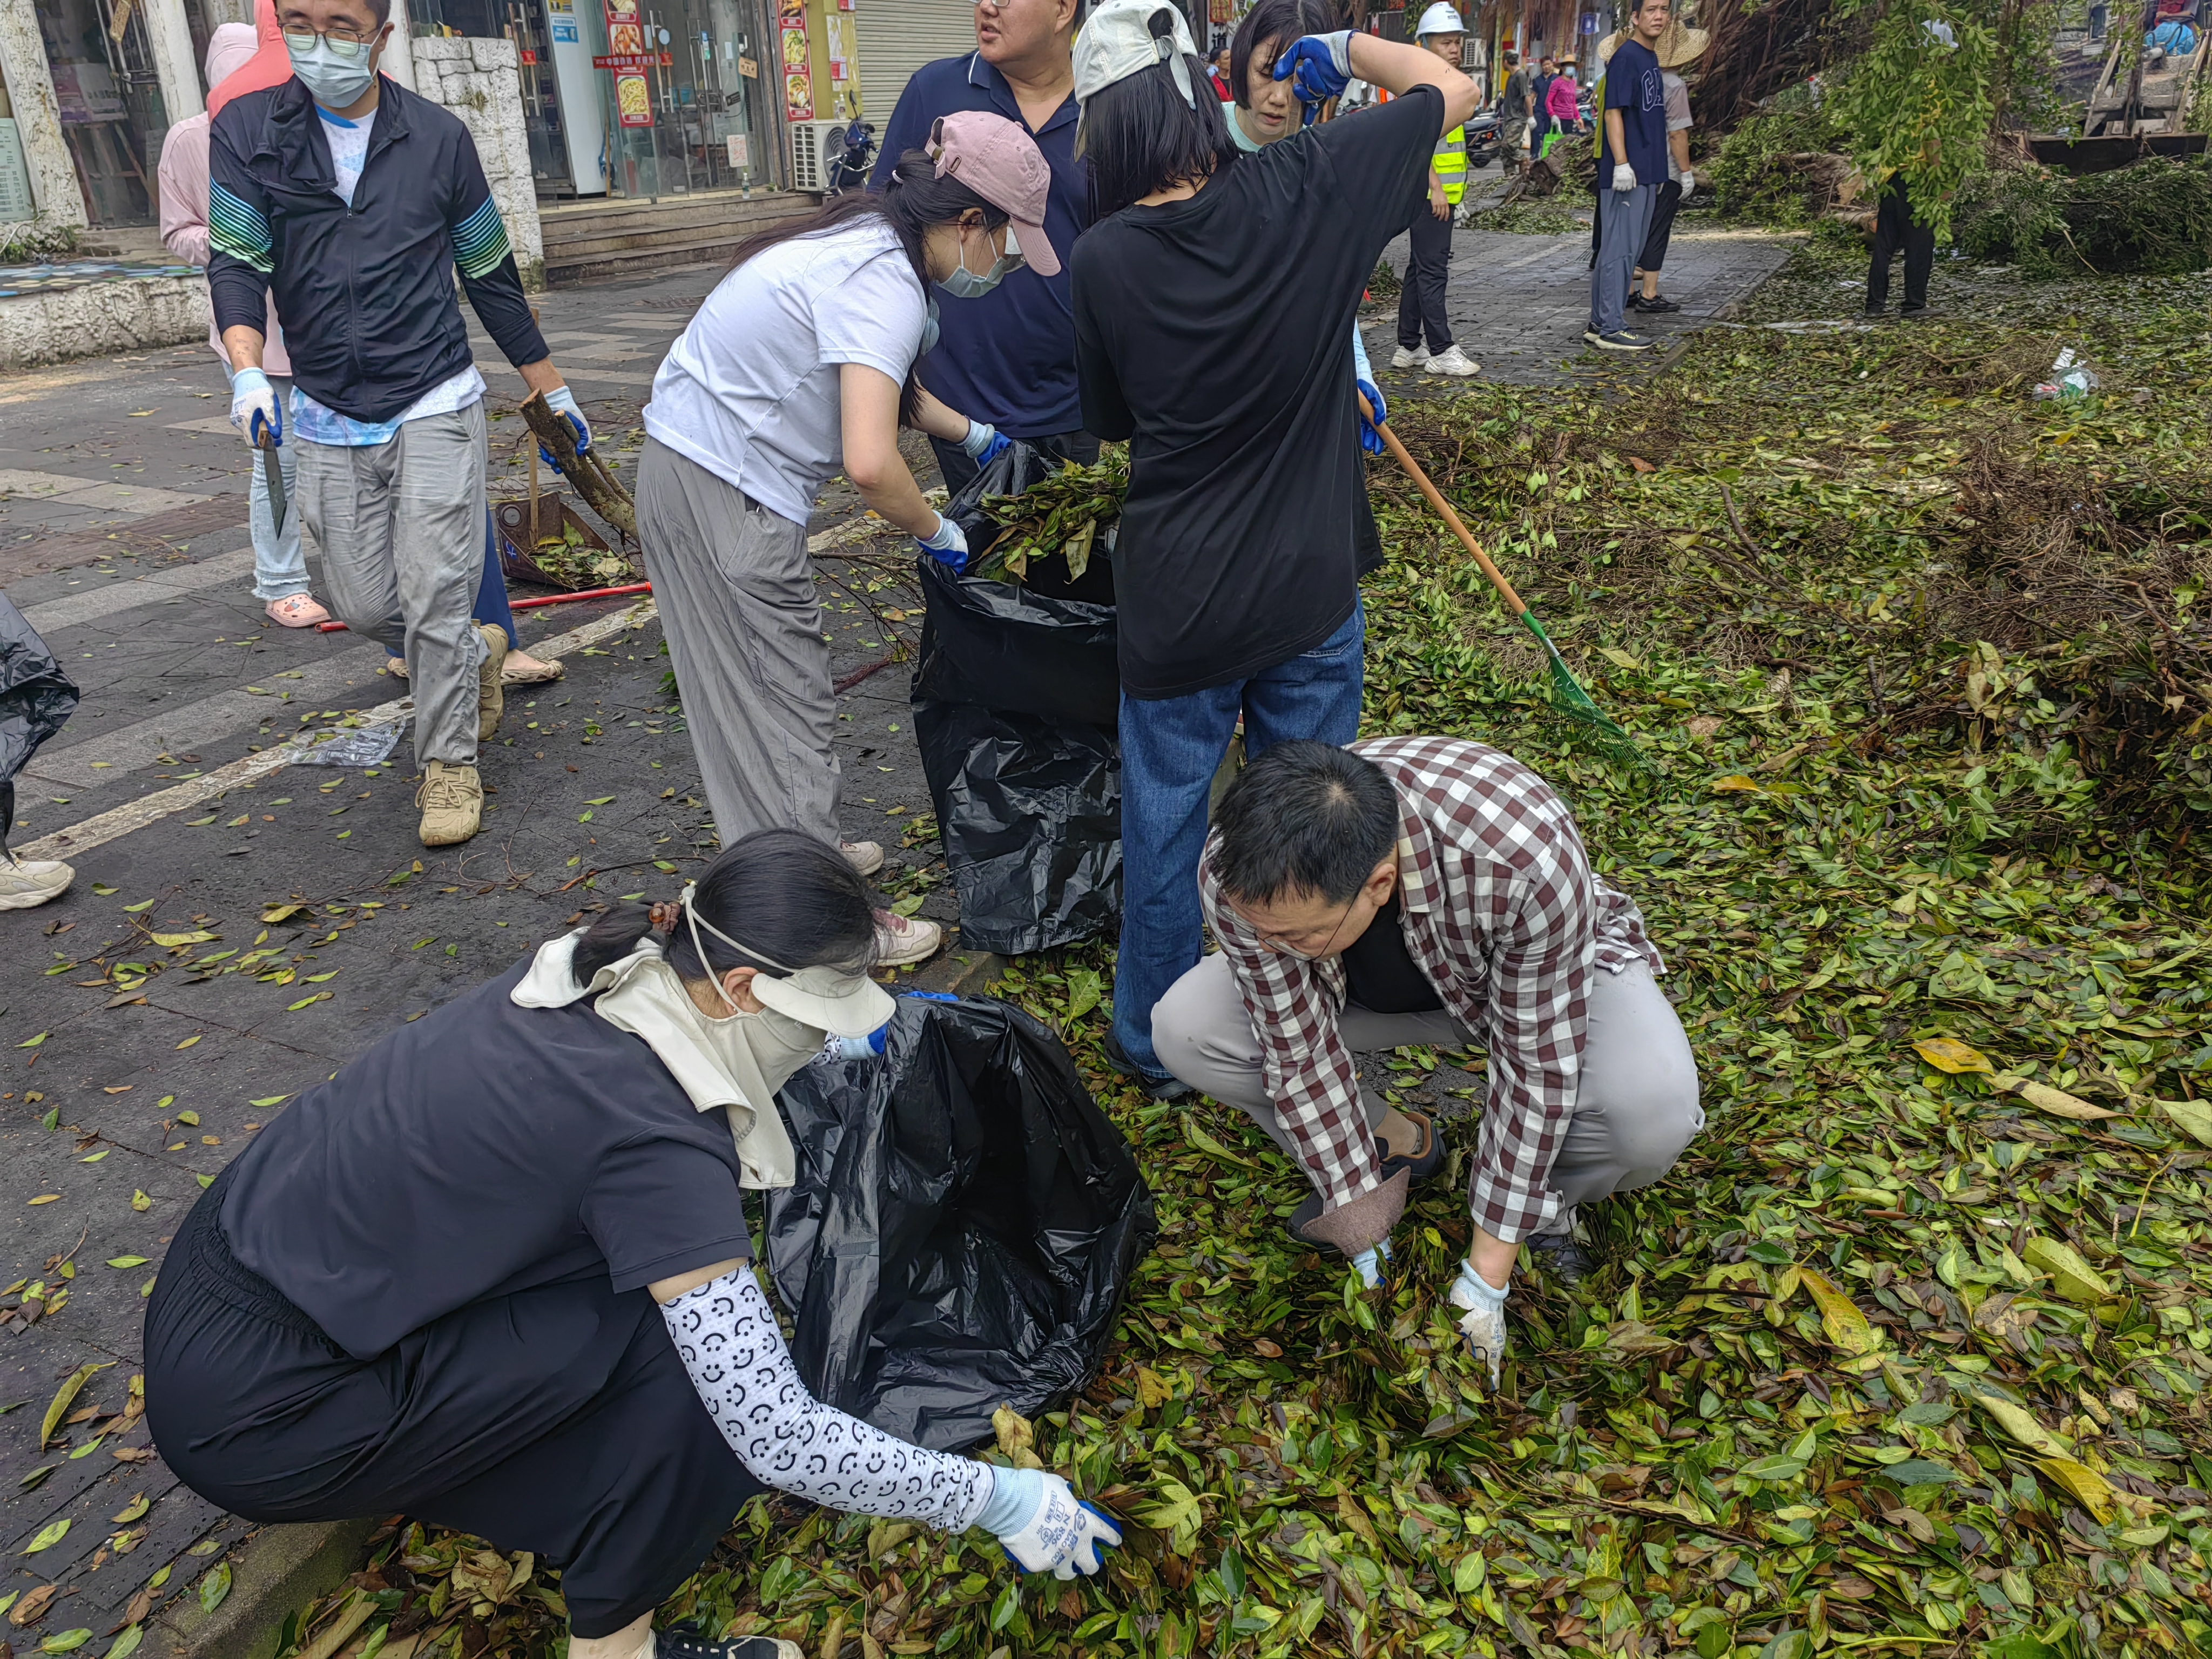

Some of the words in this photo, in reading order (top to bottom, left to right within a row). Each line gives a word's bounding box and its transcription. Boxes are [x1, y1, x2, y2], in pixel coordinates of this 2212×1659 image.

[1051, 1526, 1065, 1547] 896
[1061, 1529, 1073, 1548] BAO
[1051, 1548, 1063, 1562] YOU
